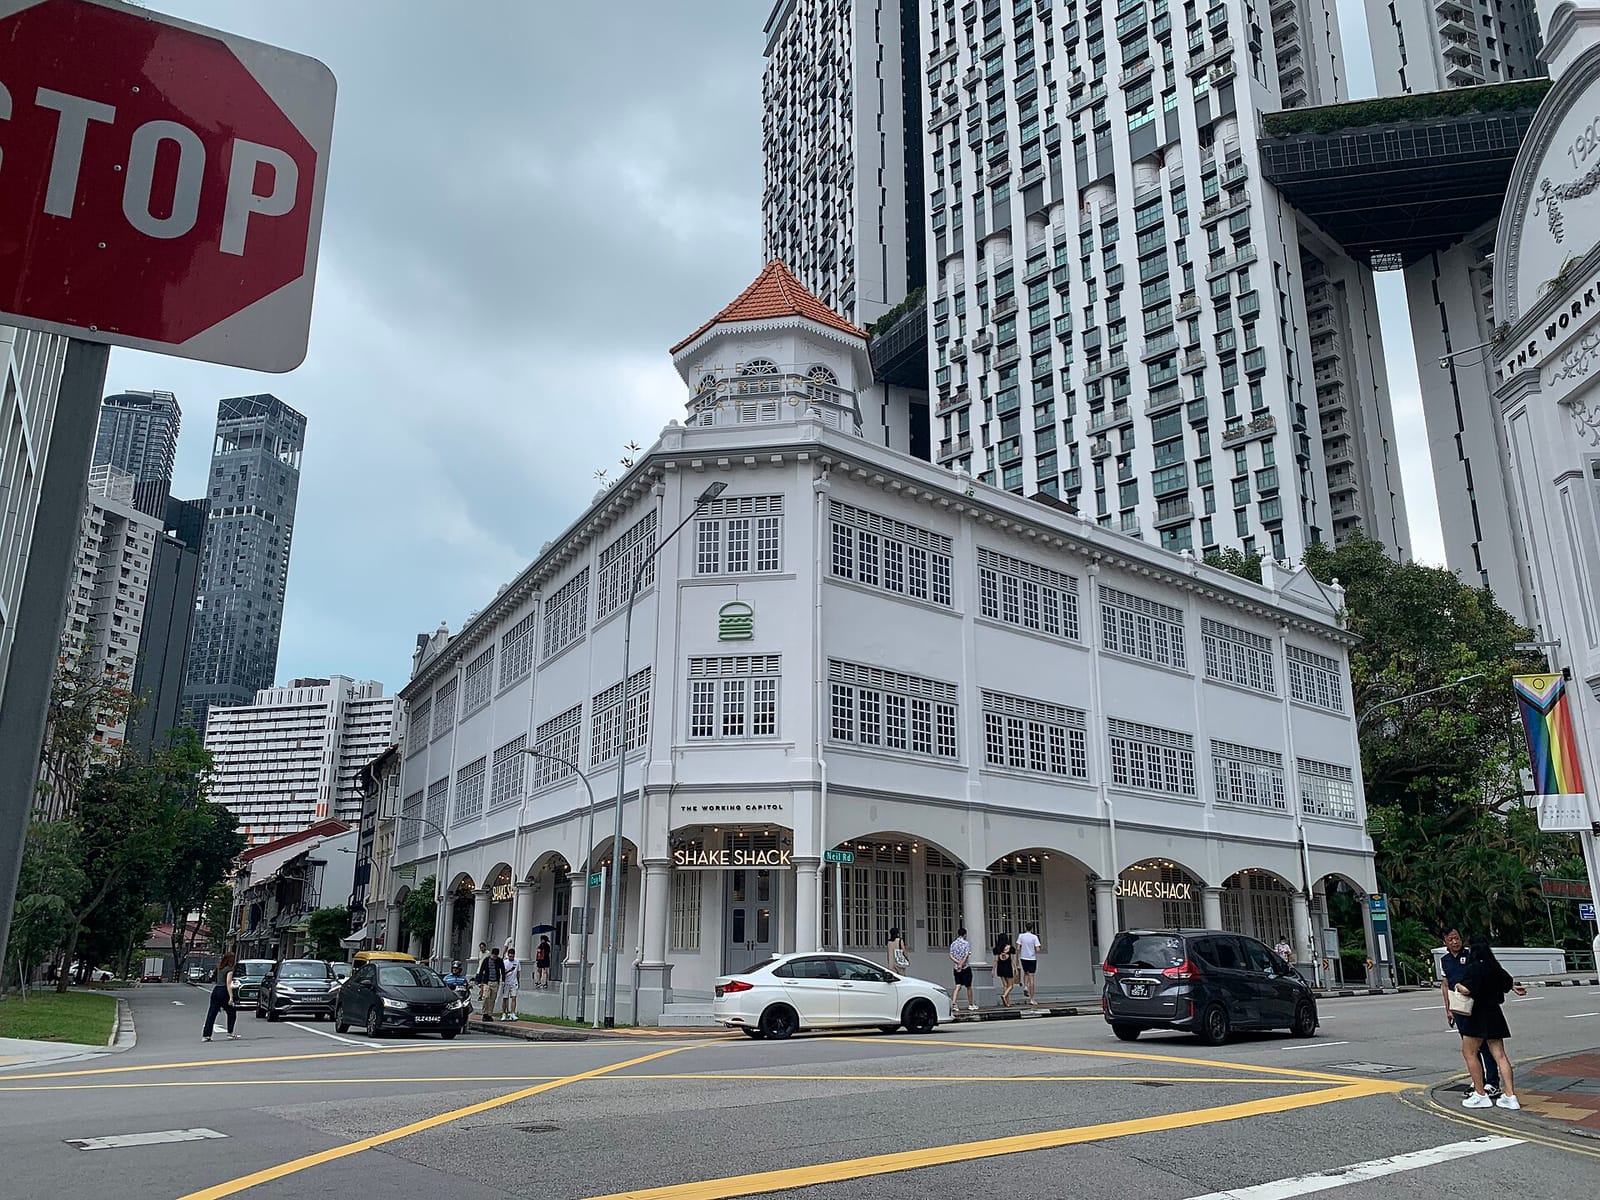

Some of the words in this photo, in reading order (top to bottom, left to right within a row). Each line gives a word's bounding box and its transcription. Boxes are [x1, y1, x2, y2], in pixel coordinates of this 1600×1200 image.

[0, 80, 299, 257] TOP
[1507, 340, 1538, 374] THE
[694, 361, 744, 376] THE
[694, 374, 826, 395] WORKING
[701, 804, 741, 812] WORKING
[745, 803, 784, 811] CAPITOL
[675, 849, 730, 866] SHAKE
[733, 849, 791, 866] SHACK
[826, 851, 841, 861] Neil
[842, 852, 851, 862] Rd
[1154, 881, 1191, 900] SHACK
